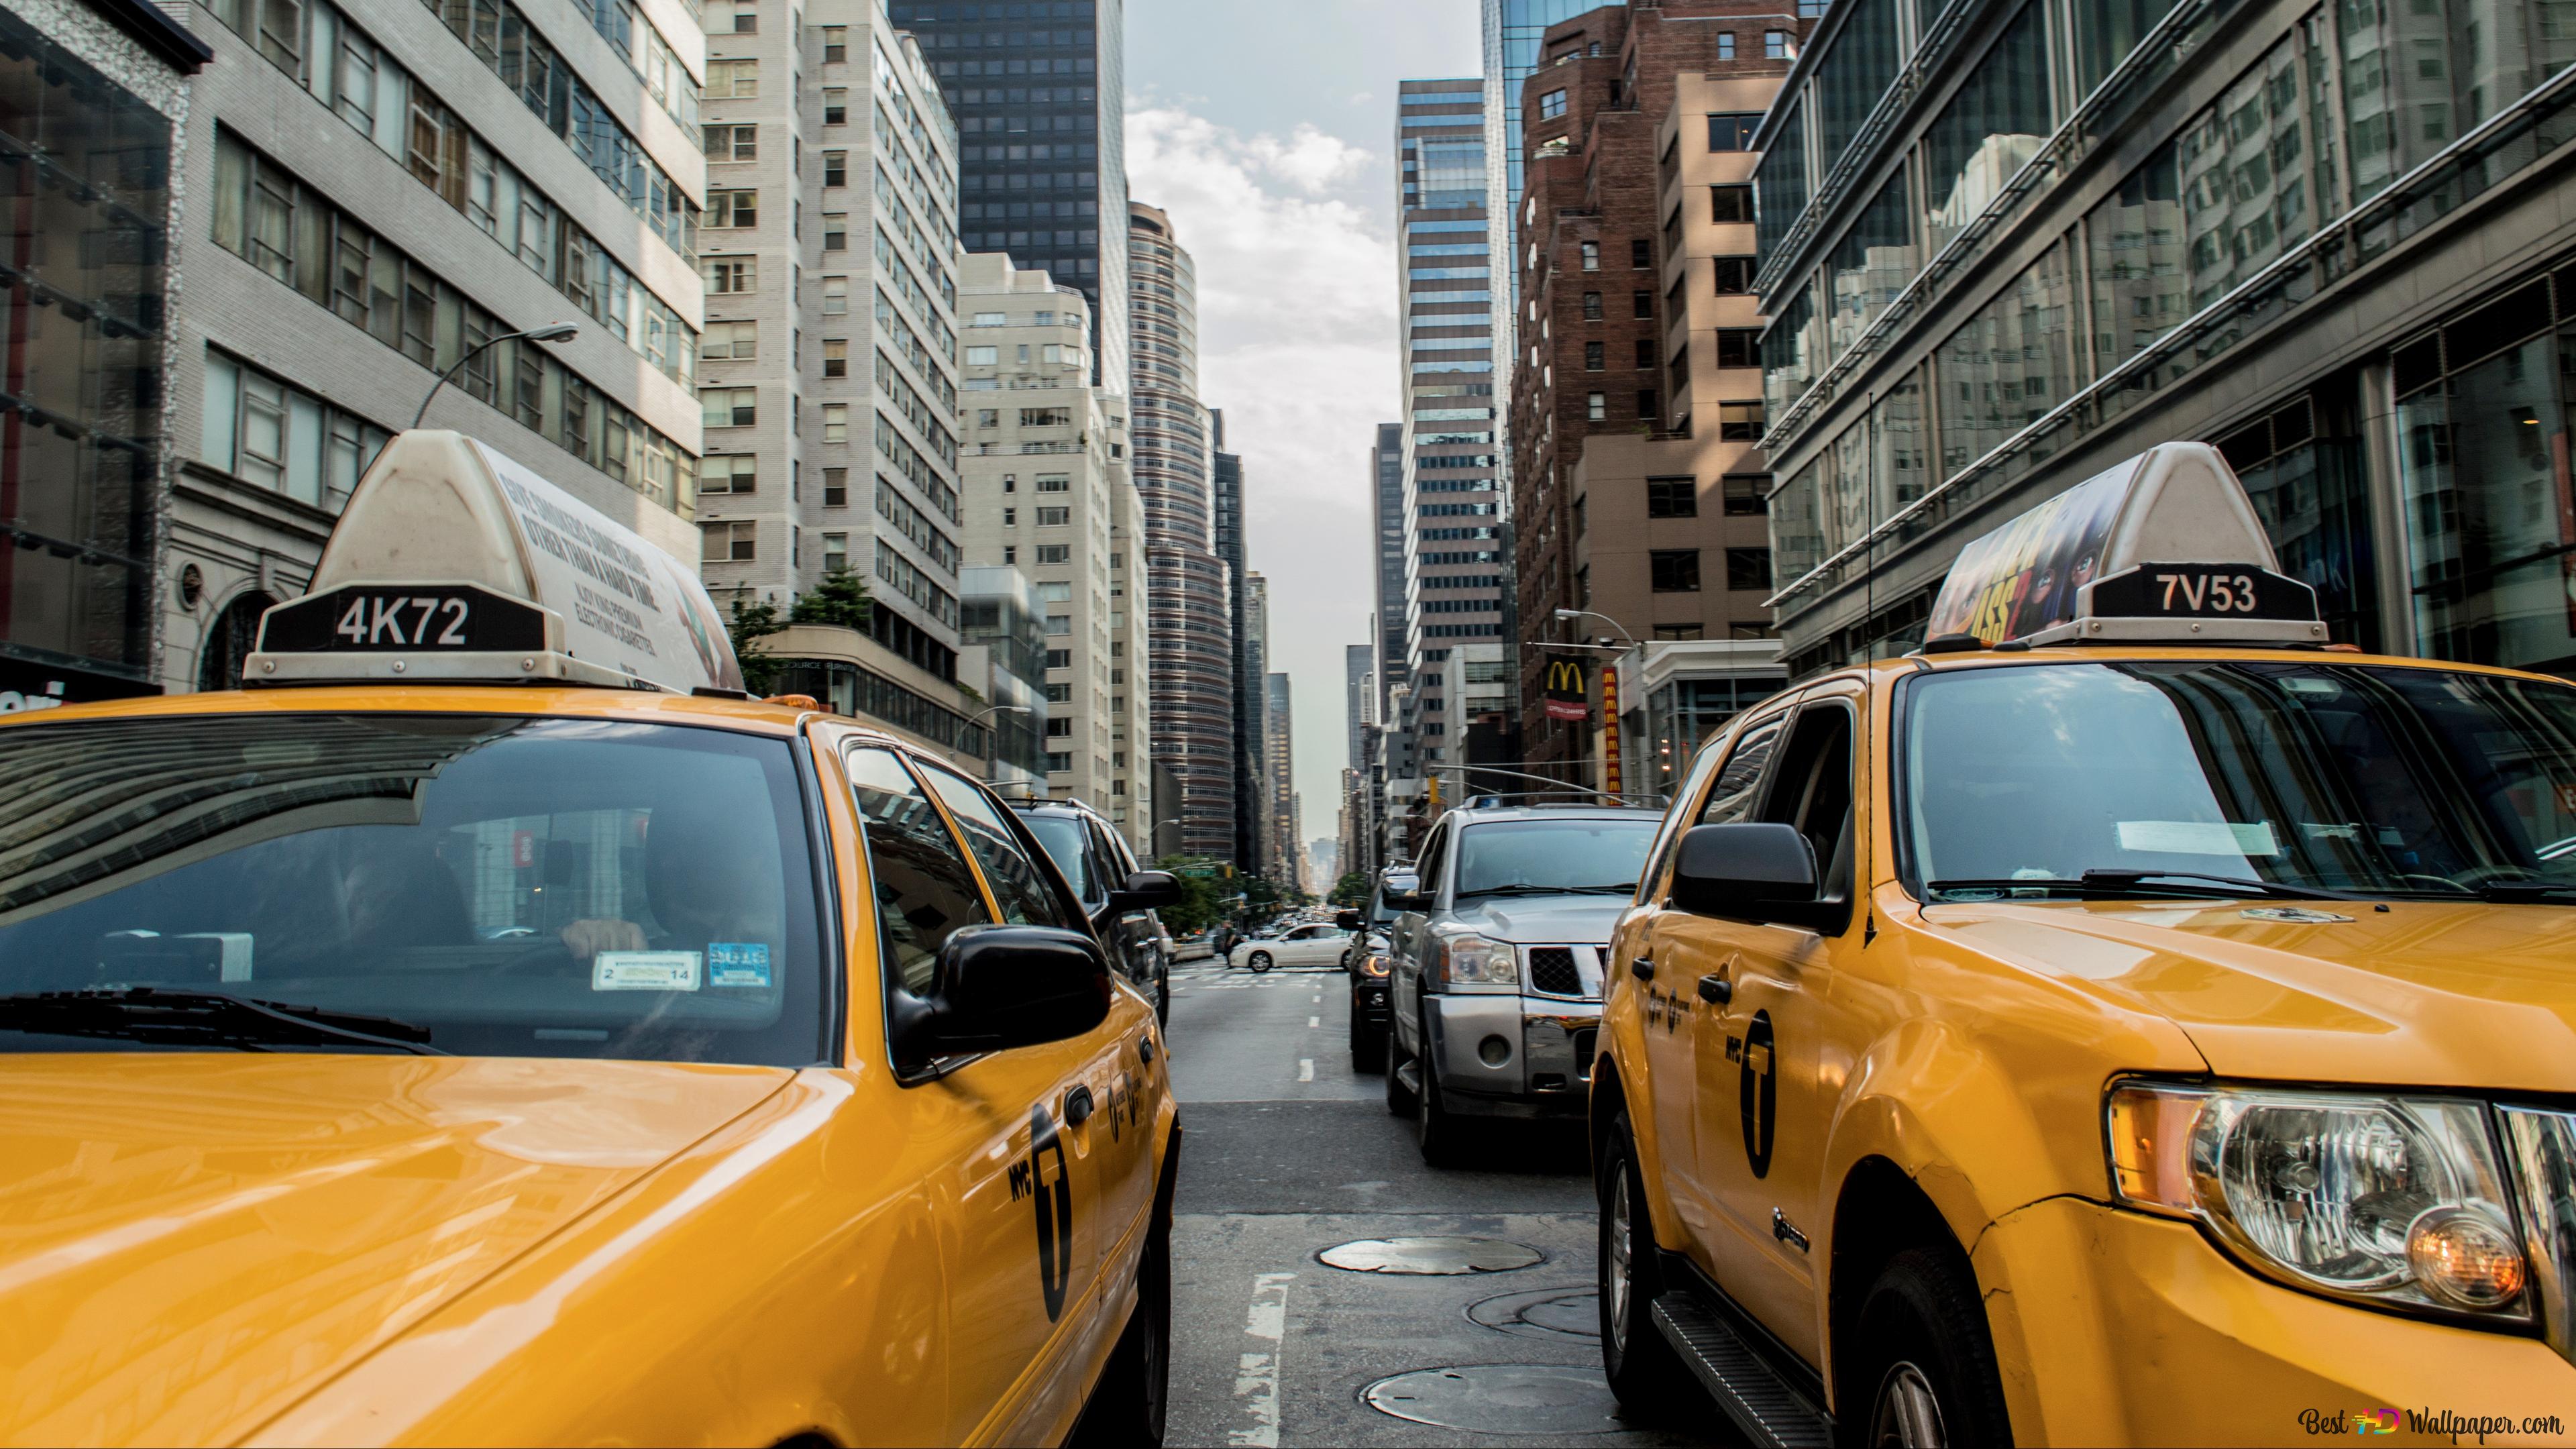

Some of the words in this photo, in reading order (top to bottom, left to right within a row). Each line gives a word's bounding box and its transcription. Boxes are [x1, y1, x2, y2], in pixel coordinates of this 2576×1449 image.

[498, 472, 537, 515] GIVE
[528, 490, 592, 547] SMOKERS
[521, 513, 569, 563] OTHER
[560, 536, 598, 580] THAN
[592, 554, 607, 585] A
[599, 558, 634, 598] HARD
[2156, 574, 2256, 612] 7V53
[337, 596, 468, 645] 4K72
[604, 969, 614, 979] 2
[671, 970, 689, 980] 14
[1008, 1159, 1032, 1202] NYC
